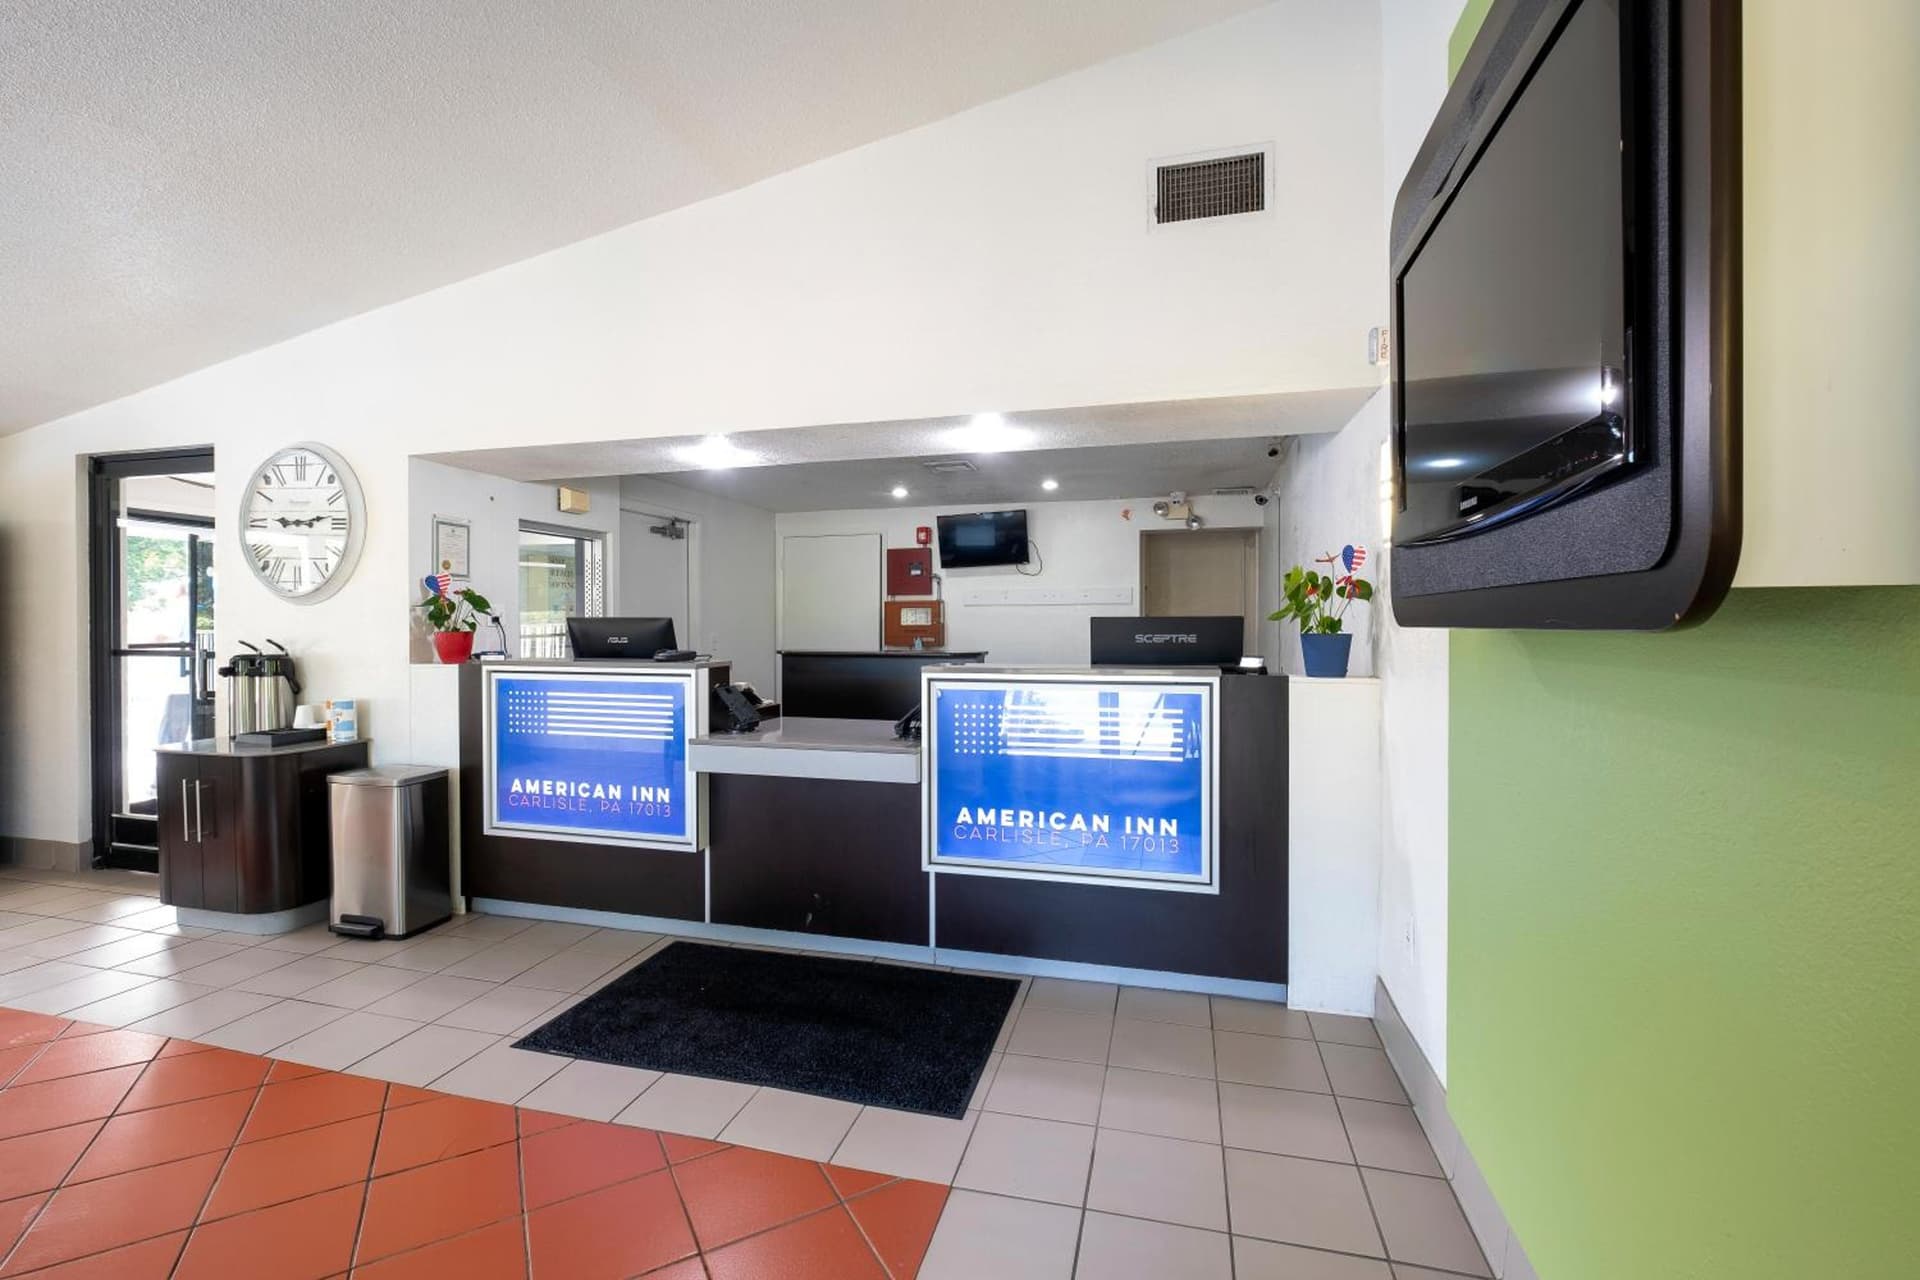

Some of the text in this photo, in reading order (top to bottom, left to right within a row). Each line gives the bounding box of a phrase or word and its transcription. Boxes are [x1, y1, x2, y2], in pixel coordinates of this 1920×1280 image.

[1134, 633, 1198, 644] SCEPTRE
[510, 778, 670, 803] AMERICAN INN
[508, 793, 672, 818] CARLISLE, PA 17013
[956, 806, 1178, 837] AMERICAN INN
[953, 824, 1179, 854] CARLISLE, PA 17013
